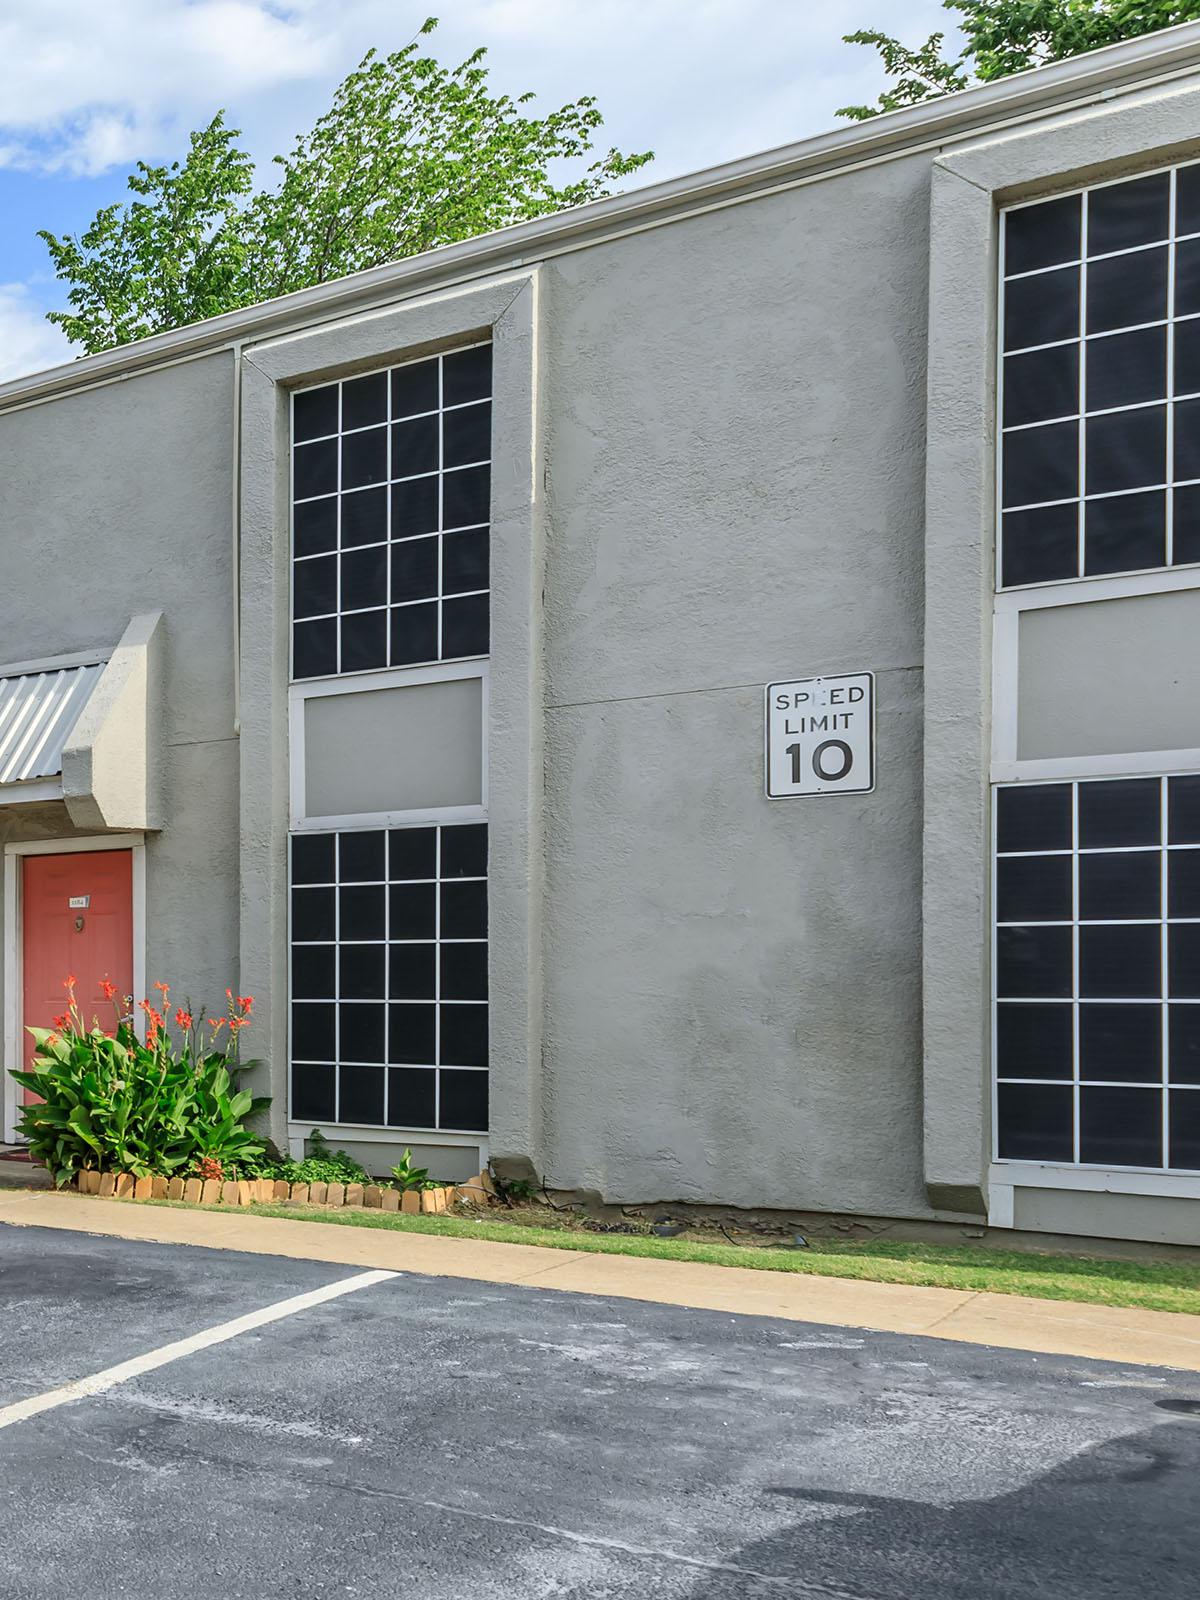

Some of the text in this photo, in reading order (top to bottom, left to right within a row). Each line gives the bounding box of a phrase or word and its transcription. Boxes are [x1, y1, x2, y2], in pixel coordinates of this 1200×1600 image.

[776, 686, 864, 710] SPED
[785, 713, 853, 735] LIMIT
[785, 739, 853, 784] 10
